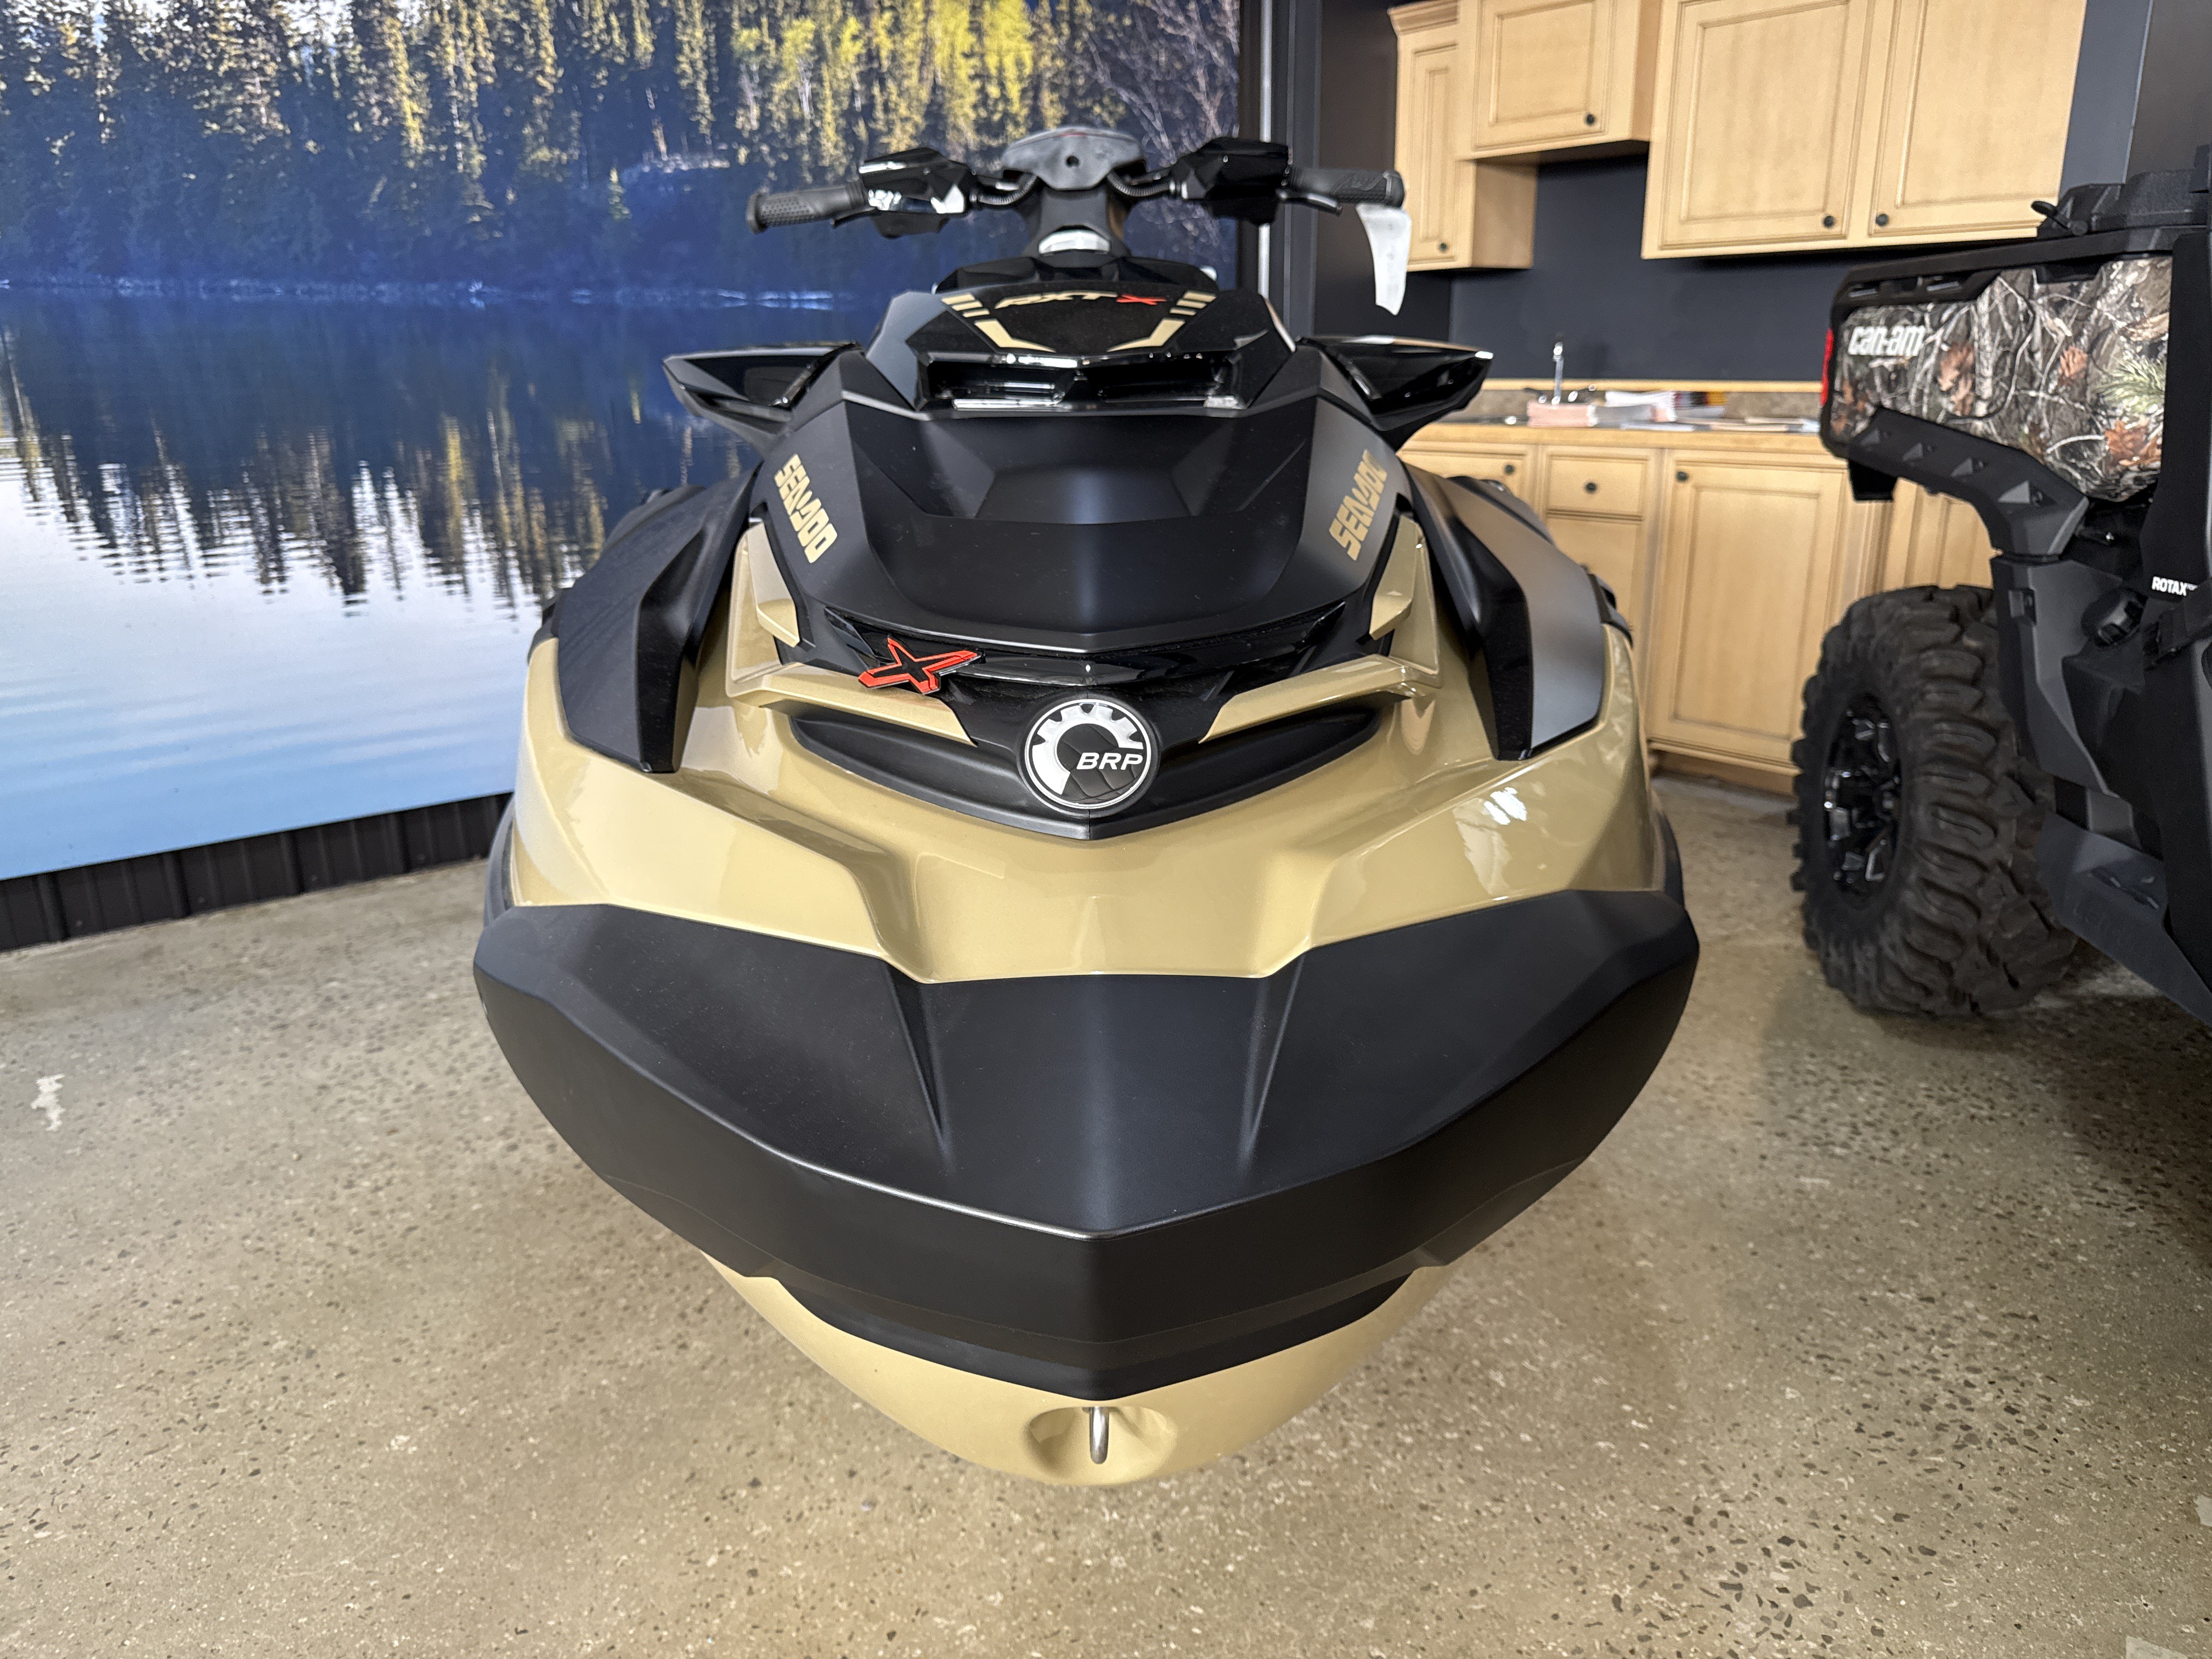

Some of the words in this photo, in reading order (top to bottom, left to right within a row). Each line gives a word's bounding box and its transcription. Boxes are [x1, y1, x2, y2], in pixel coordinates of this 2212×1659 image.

[1848, 325, 1926, 357] can-am
[2152, 576, 2187, 596] ROTAX
[1076, 752, 1143, 770] BRP
